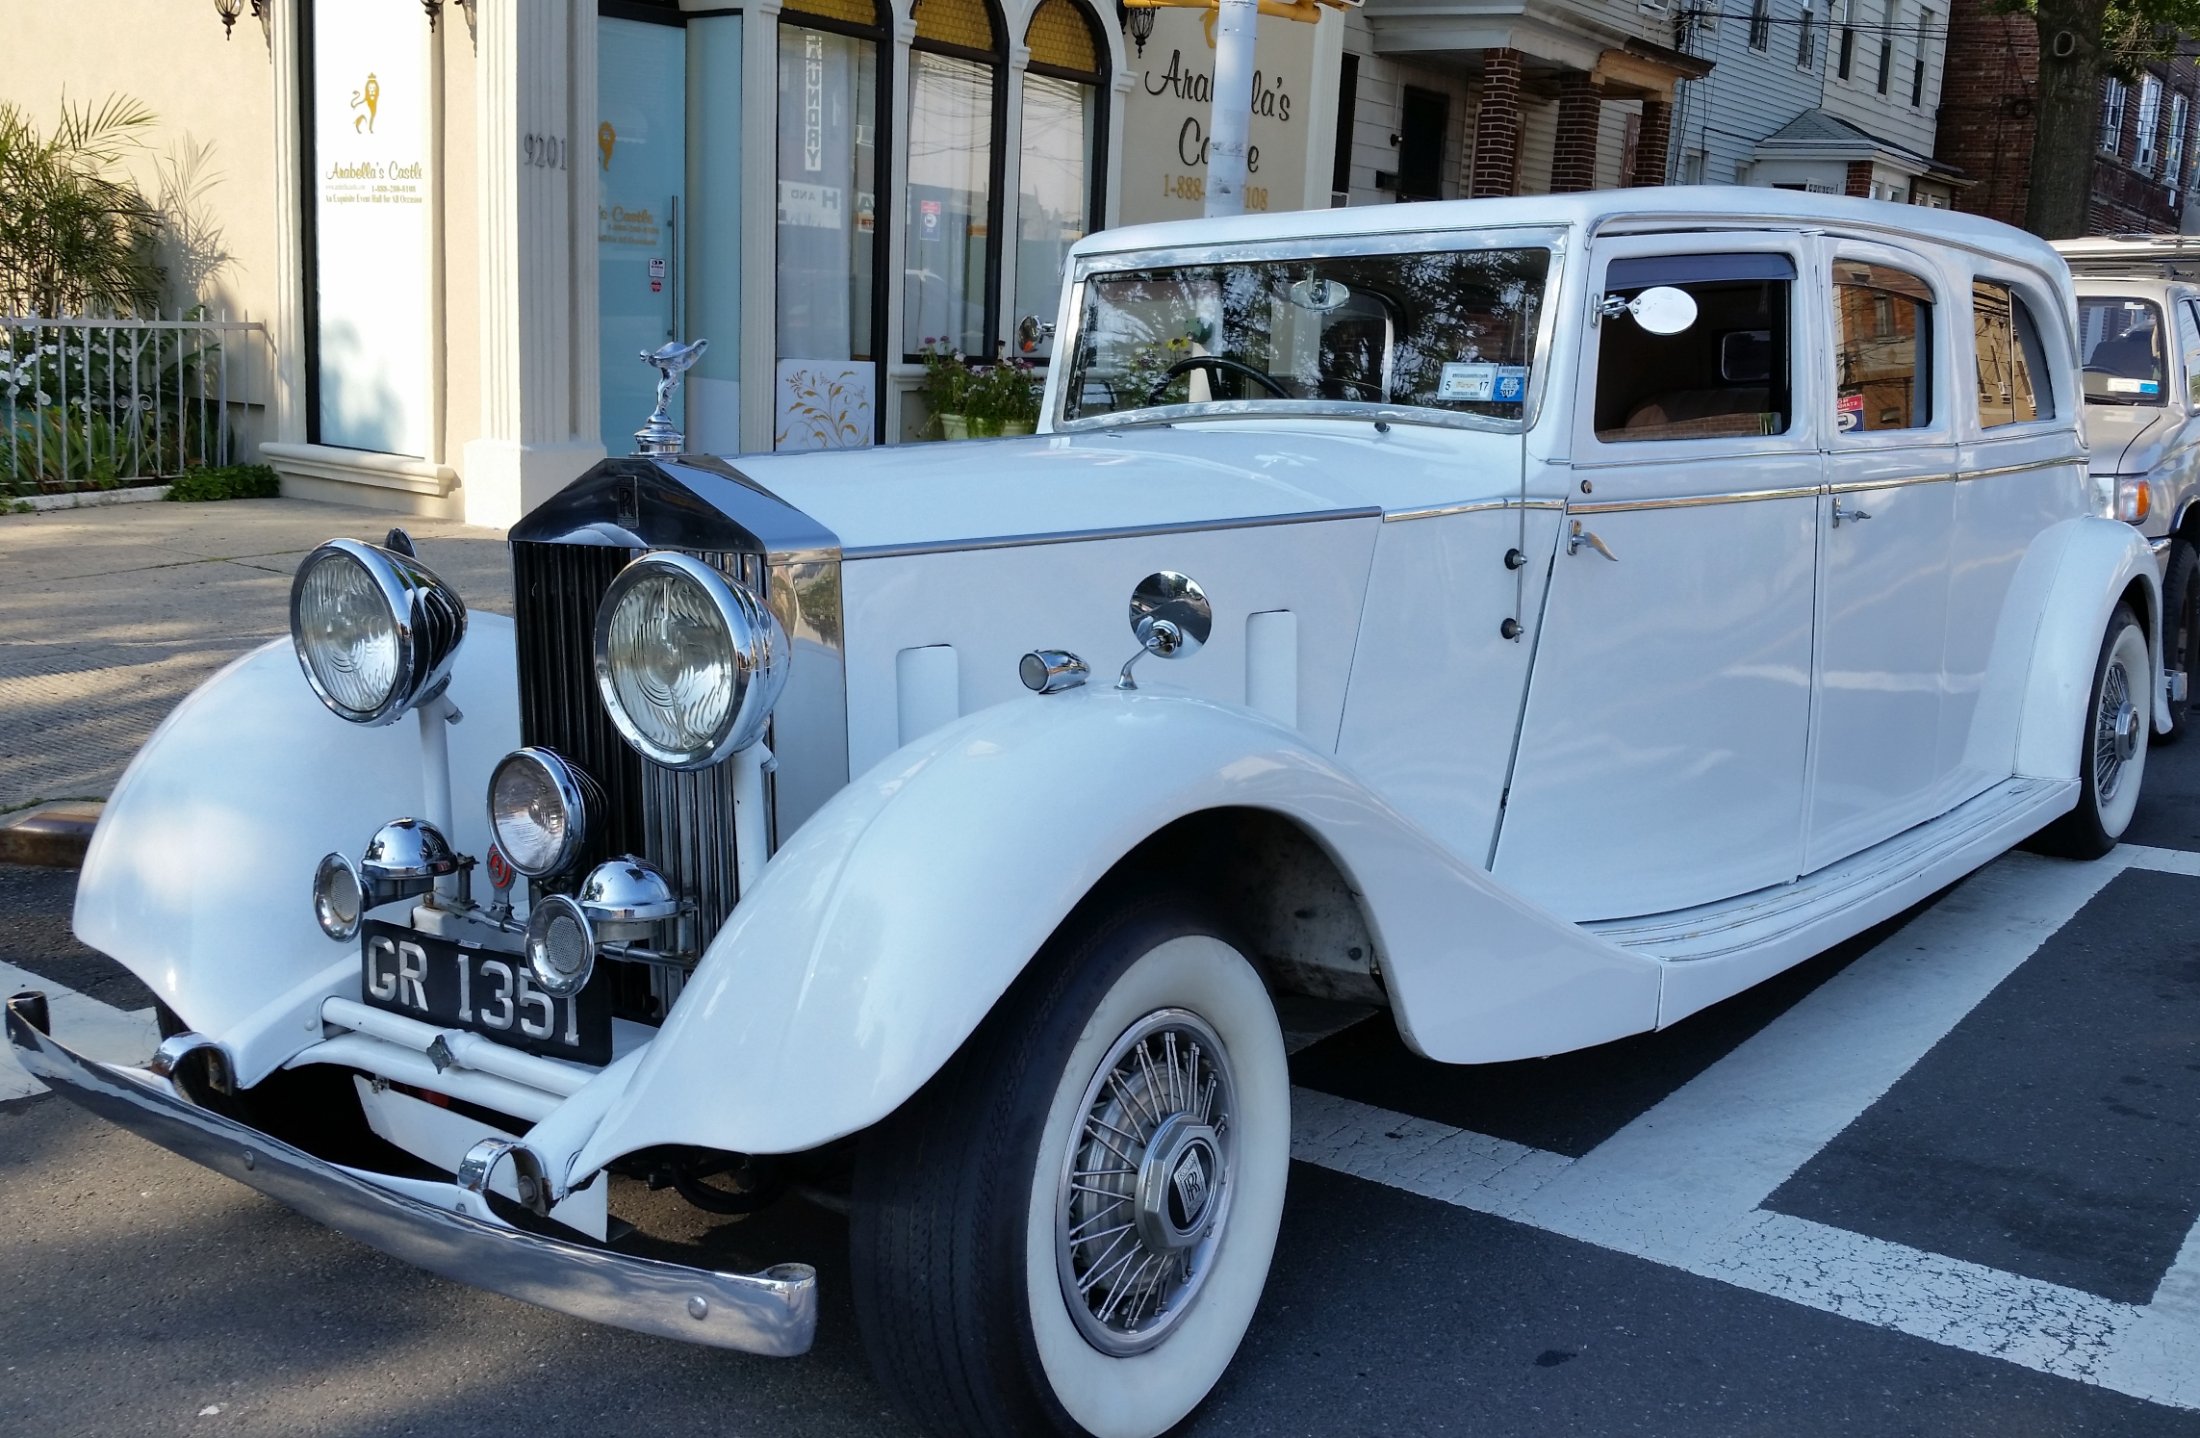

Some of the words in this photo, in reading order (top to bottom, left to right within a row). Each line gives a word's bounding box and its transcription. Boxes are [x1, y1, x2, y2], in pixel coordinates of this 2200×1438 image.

[1145, 49, 1290, 121] Arala's
[326, 161, 384, 180] Arabella's
[388, 160, 423, 181] Castle
[524, 132, 567, 171] 9201
[1163, 173, 1268, 211] 1-888--108
[1445, 381, 1451, 391] 5
[1479, 382, 1489, 391] 17
[367, 935, 429, 1013] GR
[457, 953, 580, 1047] 1351
